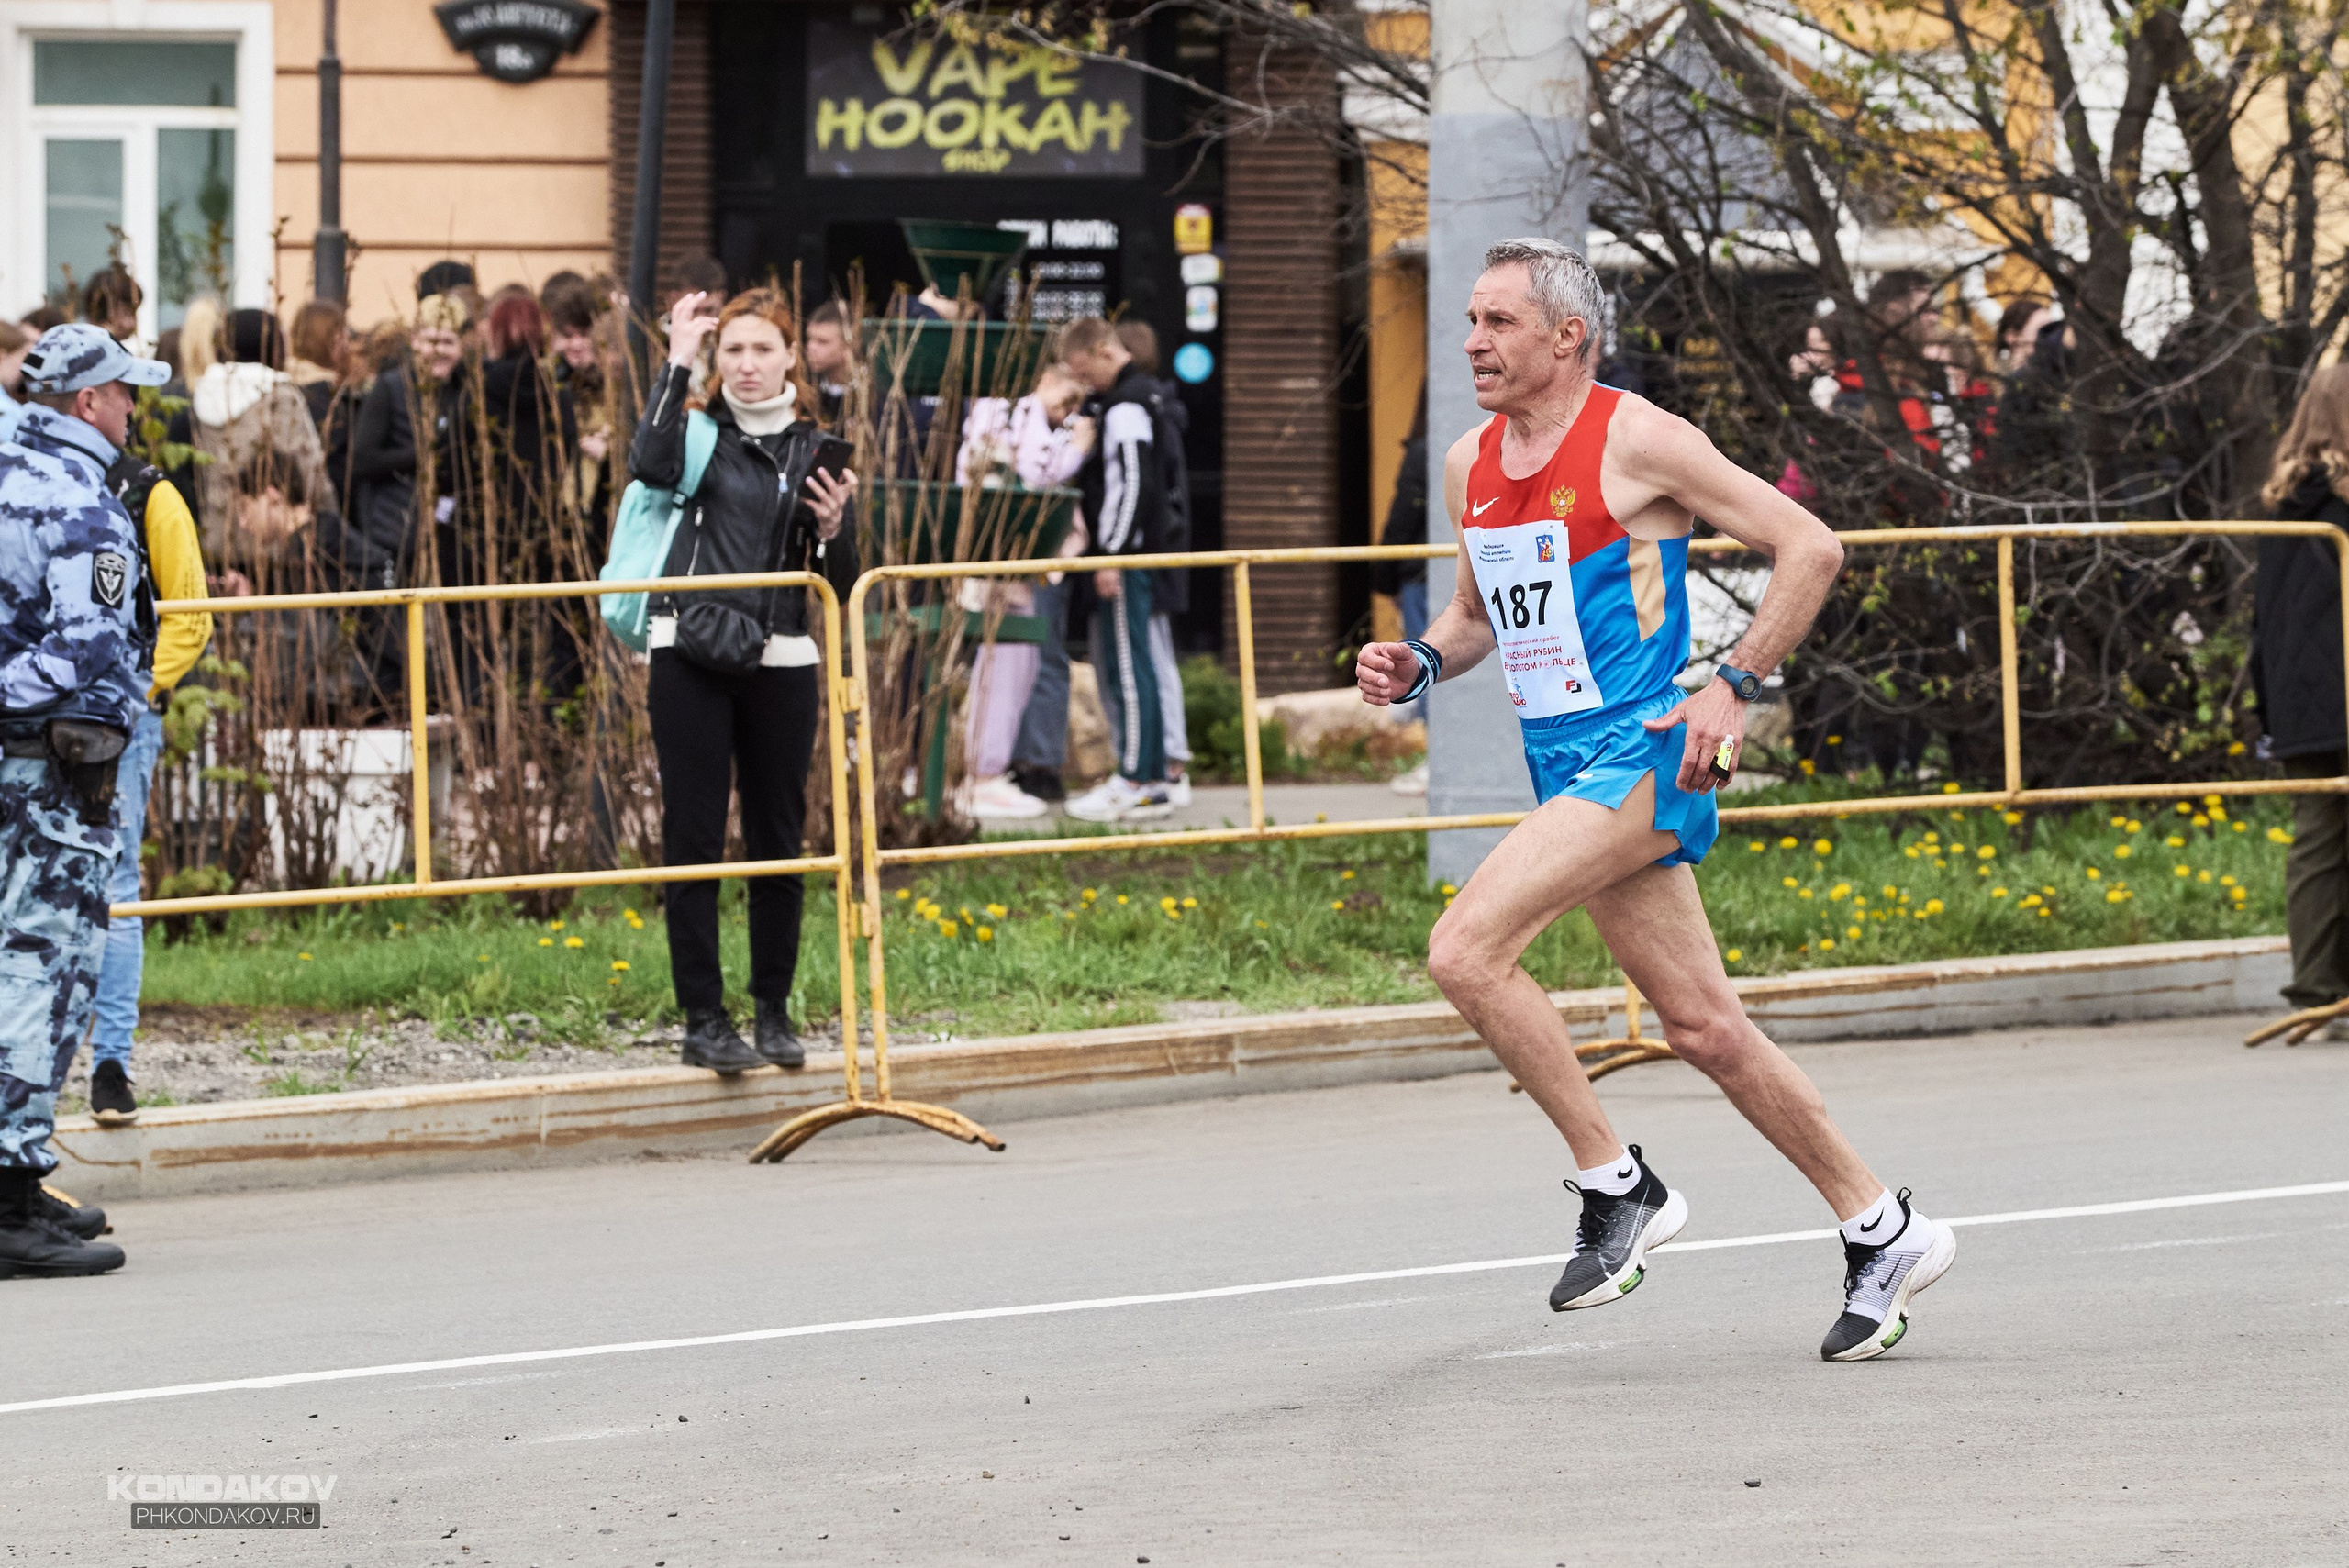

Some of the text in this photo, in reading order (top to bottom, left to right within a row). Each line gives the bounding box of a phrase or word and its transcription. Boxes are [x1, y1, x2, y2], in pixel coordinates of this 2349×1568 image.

[872, 40, 1084, 98] VAPE
[815, 96, 1133, 154] HOOKAH
[1491, 580, 1553, 630] 187
[1504, 662, 1508, 670] В
[1505, 645, 1563, 660] КРАСНЫЙ РУБИН
